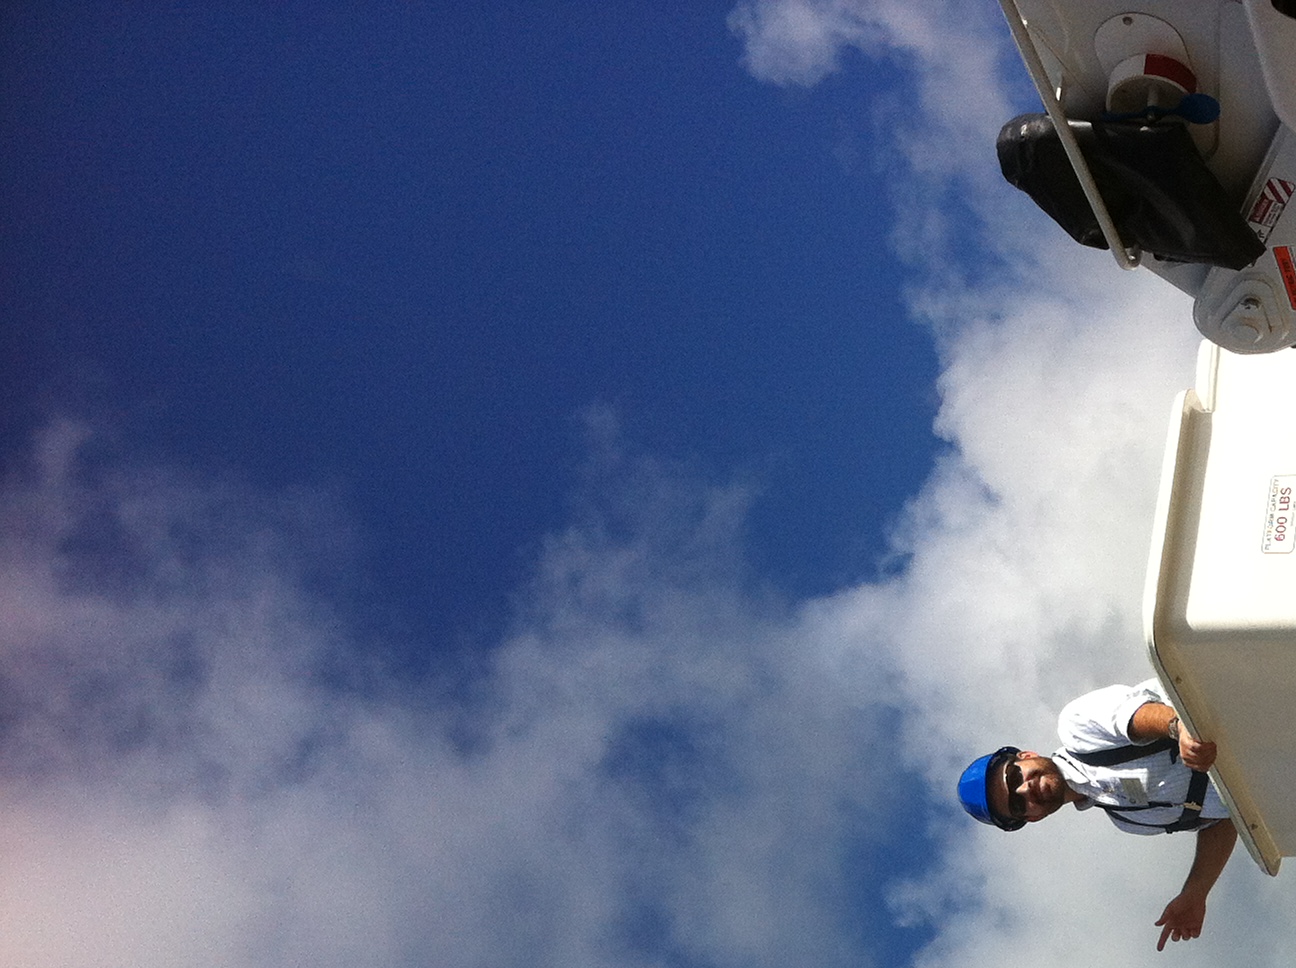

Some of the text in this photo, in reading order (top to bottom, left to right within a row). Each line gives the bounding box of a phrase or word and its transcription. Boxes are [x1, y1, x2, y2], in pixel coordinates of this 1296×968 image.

[1265, 478, 1279, 550] PLATFORM CAPACITY
[1274, 487, 1292, 542] 600 LBS
